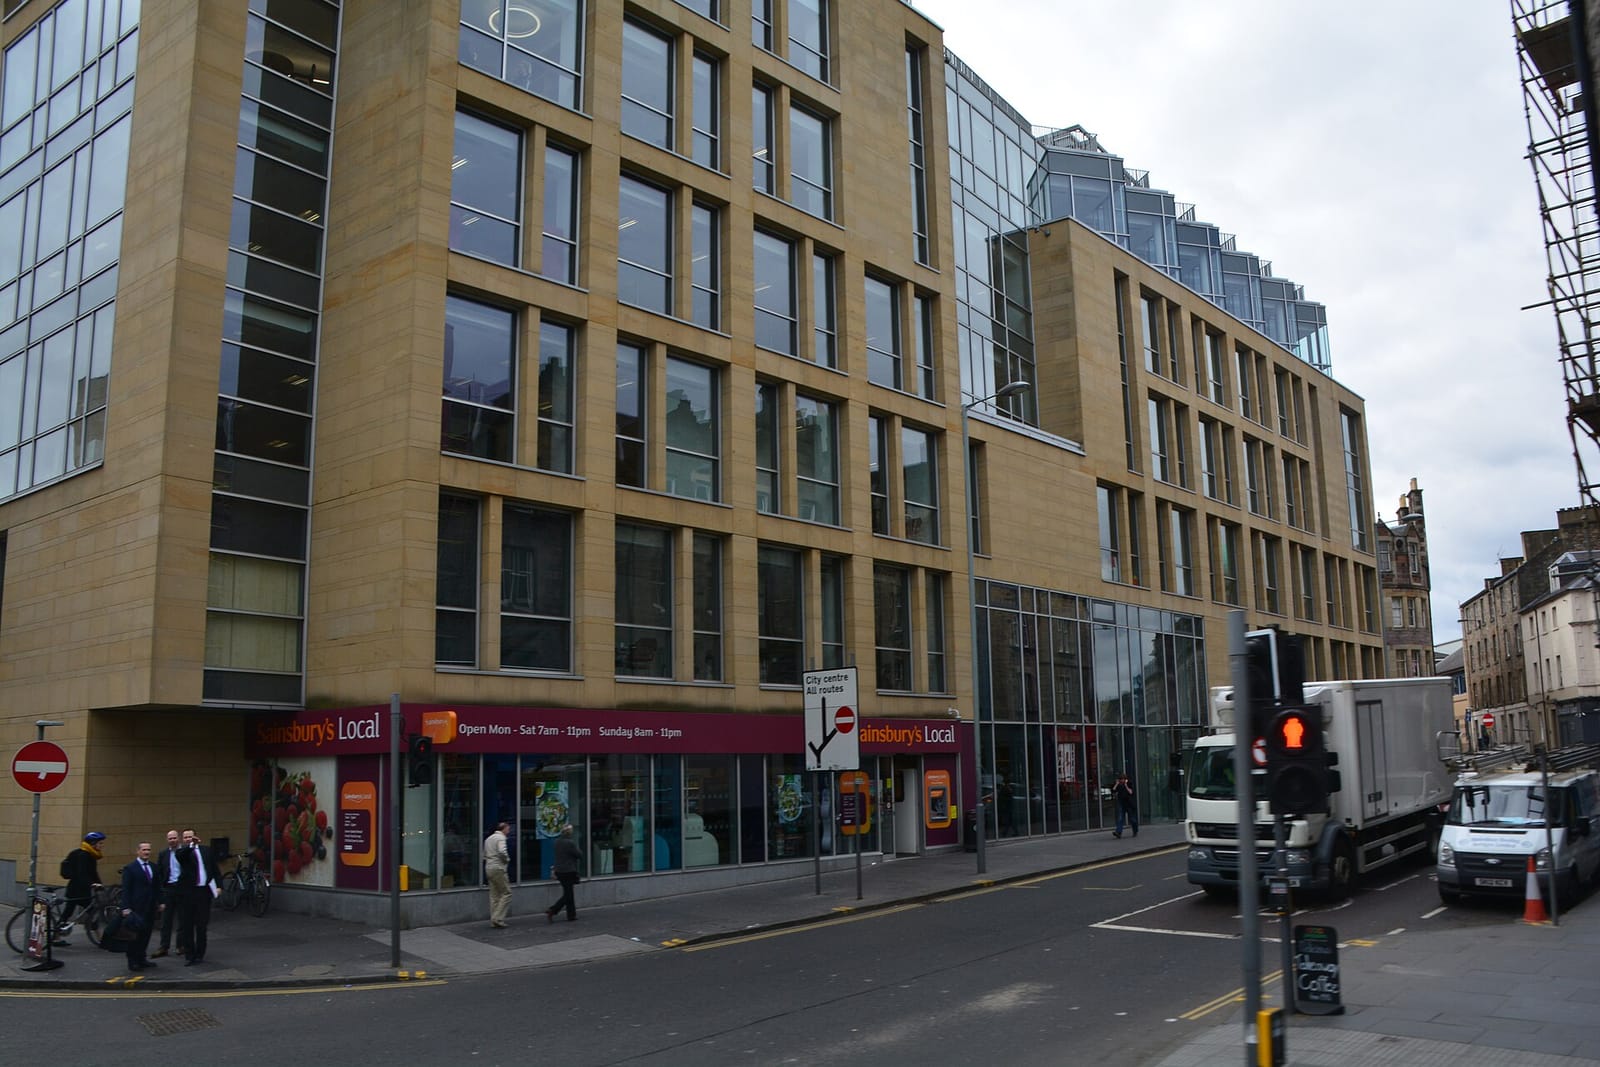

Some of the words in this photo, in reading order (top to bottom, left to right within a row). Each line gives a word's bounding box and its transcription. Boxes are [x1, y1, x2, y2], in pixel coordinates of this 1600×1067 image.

[806, 676, 821, 685] City
[823, 673, 849, 683] centre
[807, 687, 817, 695] All
[819, 685, 844, 694] routes
[256, 718, 336, 747] Sainsbury's
[338, 711, 380, 740] Local
[458, 723, 487, 736] Open
[489, 724, 511, 735] Mon
[519, 725, 536, 735] Sat
[538, 725, 559, 736] 7am
[566, 726, 591, 738] 11pm
[599, 726, 633, 739] Sunday
[634, 727, 653, 736] 8am
[660, 727, 682, 739] 11pm
[860, 724, 922, 746] ainsbury's
[924, 725, 955, 743] Local
